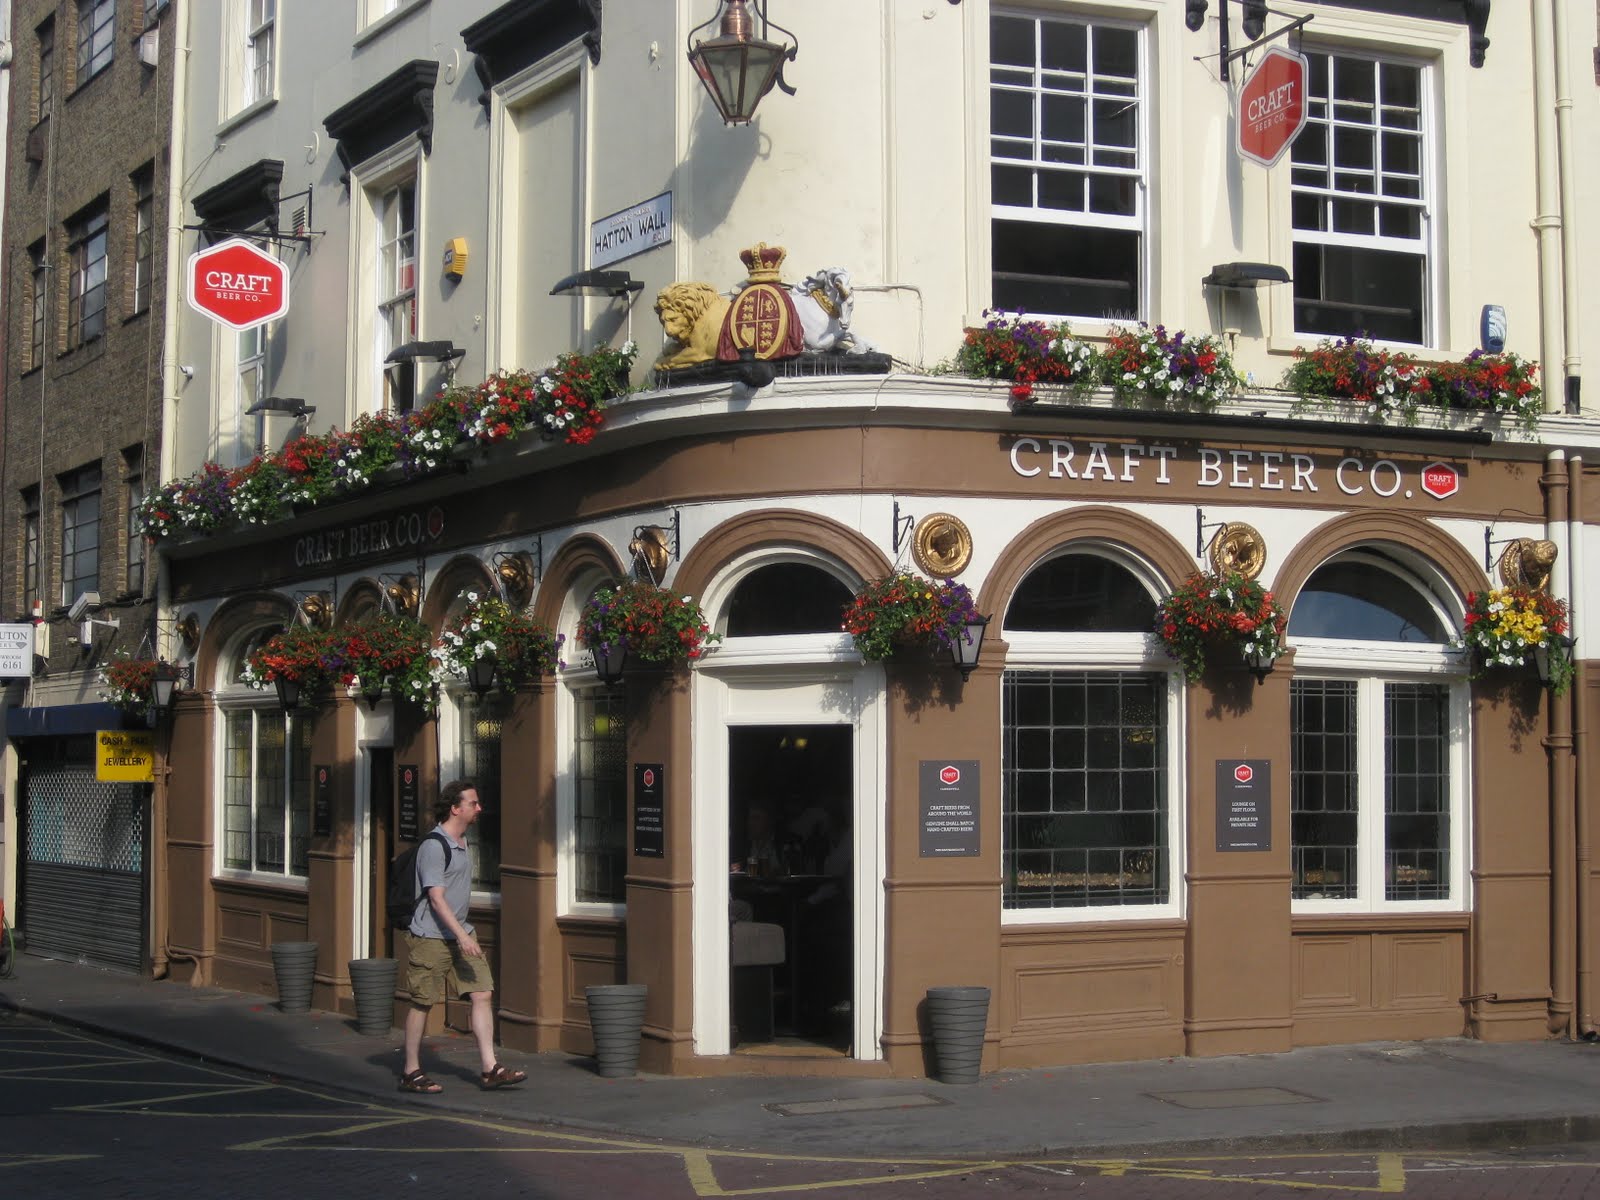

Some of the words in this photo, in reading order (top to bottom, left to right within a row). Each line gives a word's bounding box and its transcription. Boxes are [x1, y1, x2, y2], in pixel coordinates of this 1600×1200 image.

[1248, 81, 1295, 121] CRAFT
[1255, 119, 1273, 134] BEER
[595, 223, 633, 254] HATTON
[639, 210, 667, 237] WALL
[206, 271, 272, 292] CRAFT
[216, 292, 241, 300] BEER
[244, 294, 262, 302] CO.
[1009, 437, 1177, 484] CRAFT
[1196, 447, 1318, 493] BEER
[1335, 456, 1413, 499] CO.
[1428, 474, 1452, 484] CRAFT
[295, 529, 345, 567] CRAFT
[350, 519, 391, 557] BEER
[395, 512, 426, 547] CO.
[2, 660, 23, 670] 6161
[101, 736, 124, 746] CASH
[104, 757, 147, 767] JEWELLERY
